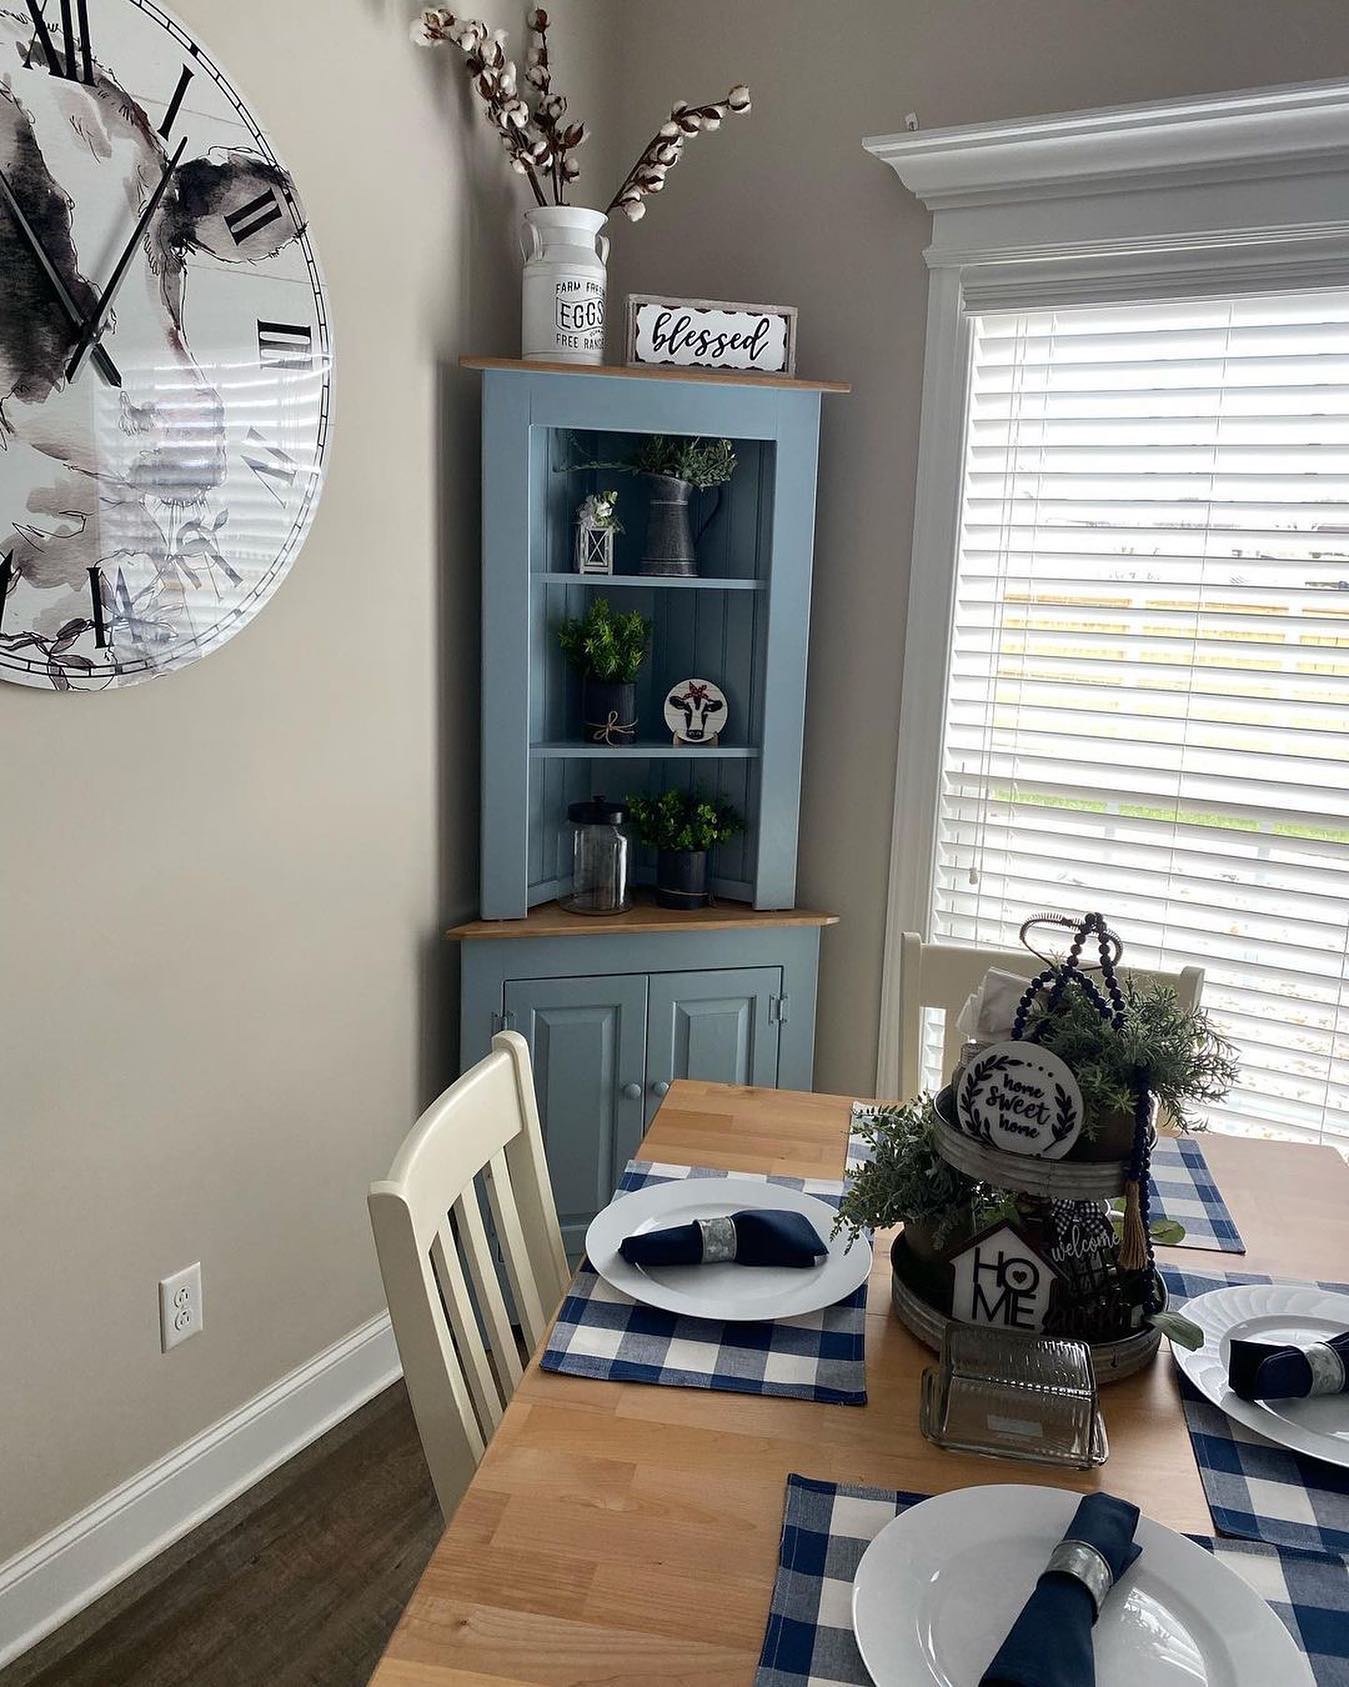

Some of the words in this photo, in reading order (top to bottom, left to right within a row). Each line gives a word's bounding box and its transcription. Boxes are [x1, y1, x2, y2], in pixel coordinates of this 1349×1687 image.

[556, 281, 581, 294] FARM
[586, 282, 605, 298] FRE
[560, 300, 604, 329] EGGS
[556, 333, 579, 349] FREE
[652, 312, 770, 361] blessed
[1003, 1073, 1044, 1098] home
[999, 1113, 1040, 1139] home
[1051, 1225, 1120, 1262] welcome
